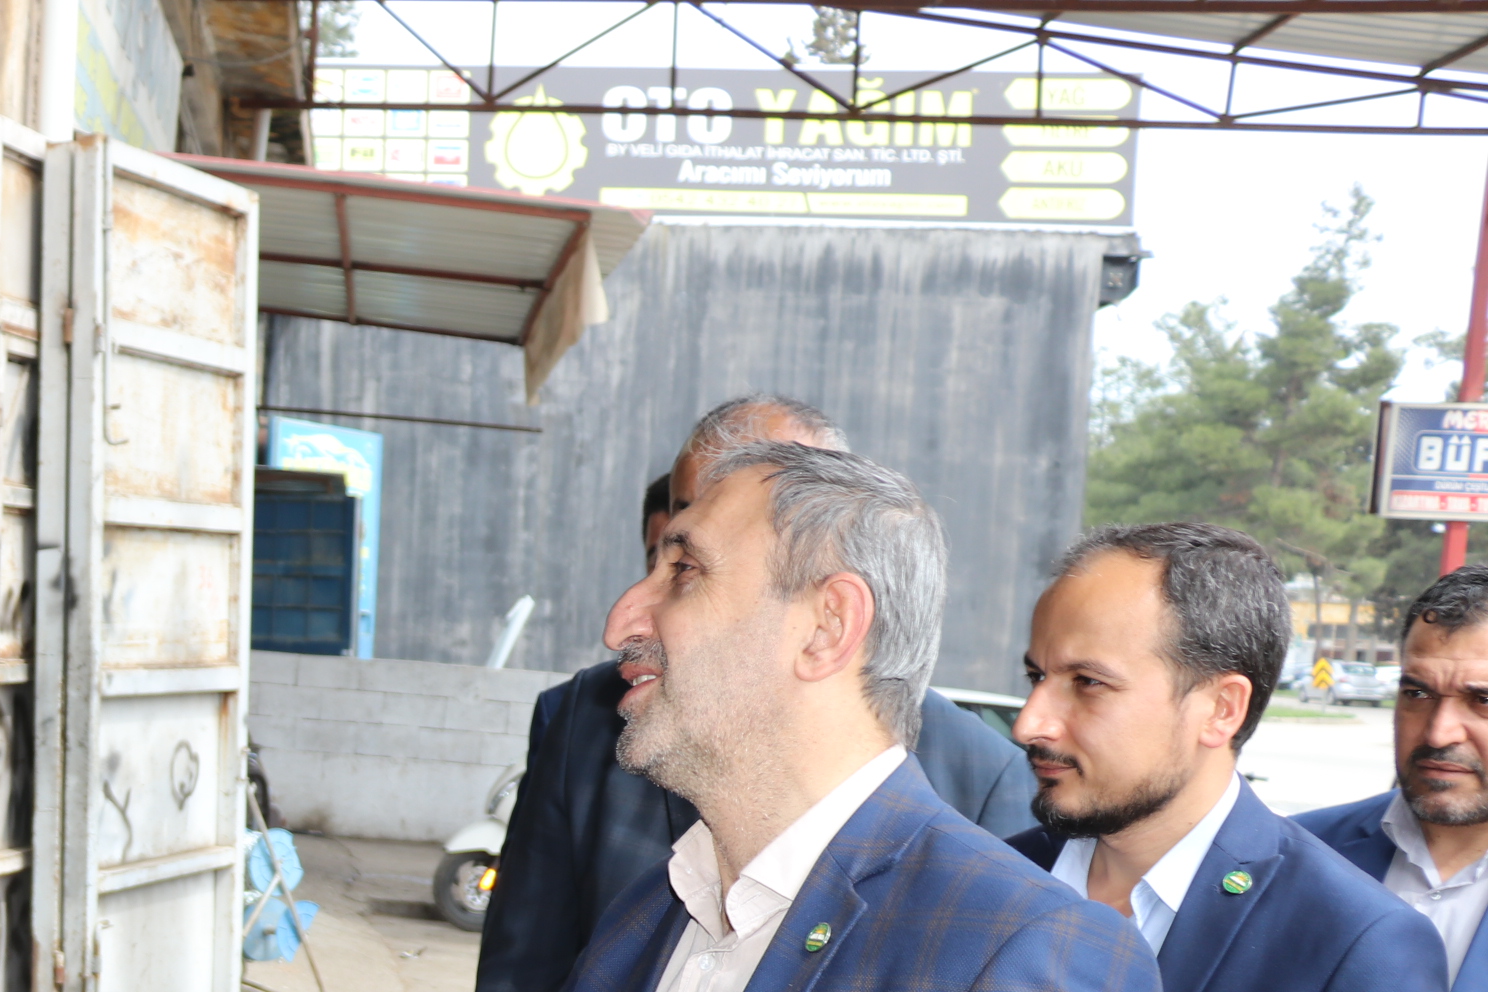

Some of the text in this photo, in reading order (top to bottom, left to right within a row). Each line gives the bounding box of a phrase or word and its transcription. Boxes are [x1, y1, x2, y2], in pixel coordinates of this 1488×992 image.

[602, 77, 973, 147] OTO YAĞIM
[605, 142, 628, 157] BY
[629, 142, 663, 157] VELİ
[665, 144, 703, 158] GIDA
[704, 143, 765, 160] İTHALAT
[766, 145, 831, 161] İHRACAT
[677, 158, 892, 190] Aracımı Seviyorum
